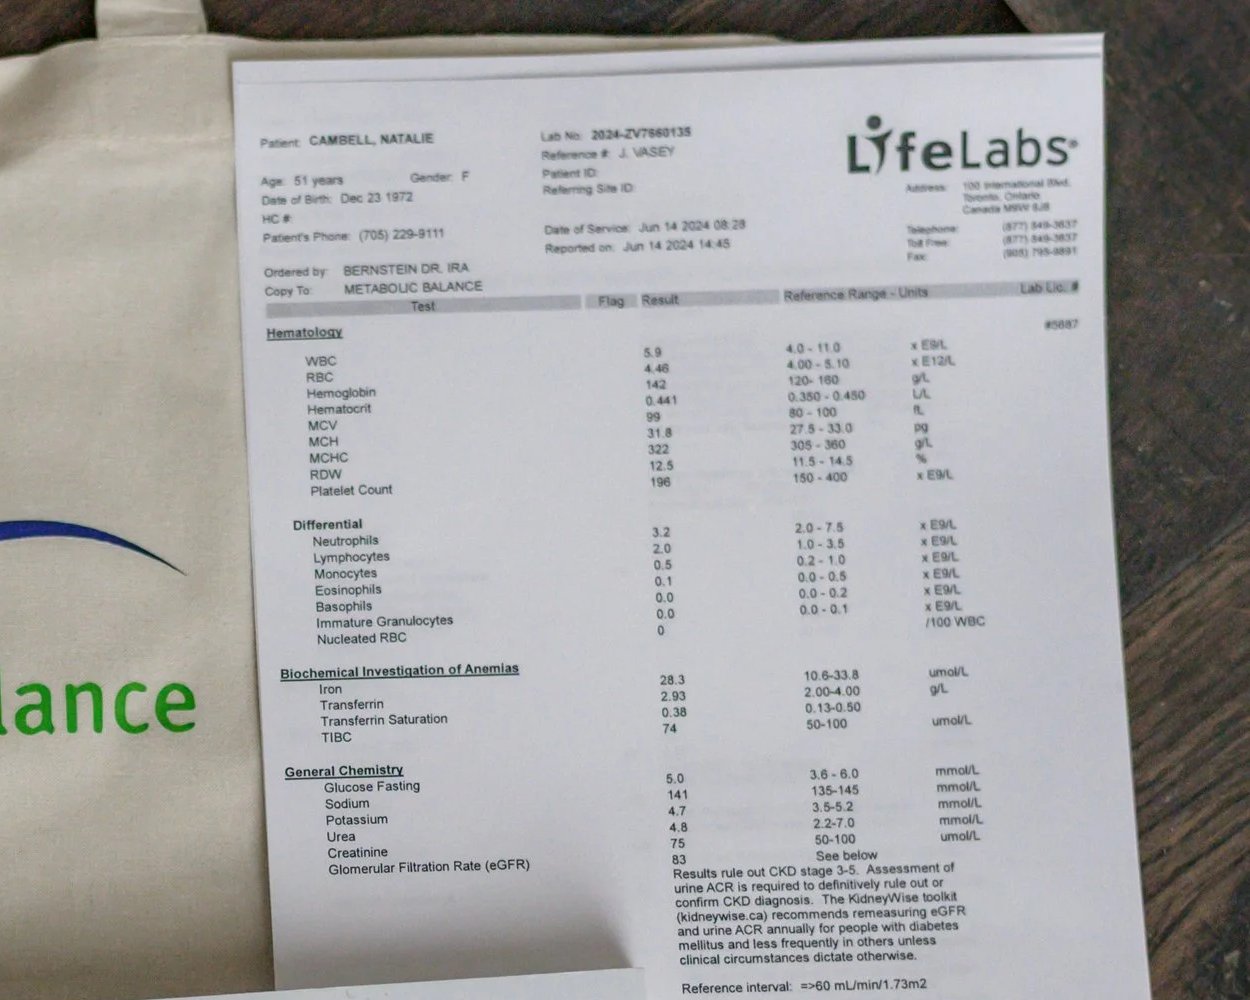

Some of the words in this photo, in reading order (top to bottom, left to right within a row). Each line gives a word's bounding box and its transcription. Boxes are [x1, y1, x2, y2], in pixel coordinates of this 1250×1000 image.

[266, 326, 343, 341] Hematology
[304, 354, 337, 367] WBC
[305, 370, 334, 383] RBC
[306, 386, 376, 401] Hemoglobin
[306, 402, 372, 415] Hematocrit
[307, 419, 338, 431] MCV
[308, 435, 339, 447] MCH
[308, 451, 349, 464] MCHC
[309, 468, 342, 480] RDW
[310, 484, 355, 497] Platelet
[357, 483, 393, 496] Count
[292, 517, 363, 531] Differential
[312, 534, 379, 548] Neutrophils
[312, 551, 390, 566] Lymphocytes
[313, 567, 378, 581] Monocytes
[314, 583, 382, 597] Eosinophils
[315, 599, 373, 614] Basophils
[316, 617, 373, 629] Immature
[375, 614, 454, 629] Granulocytes
[316, 632, 377, 645] Nucleated
[379, 631, 407, 643] RBC
[280, 667, 359, 681] Biochemical
[362, 665, 446, 680] Investigation
[448, 664, 462, 677] of
[464, 663, 519, 676] Anemias
[318, 683, 342, 695] Iron
[319, 698, 384, 711] Transferrin
[319, 714, 385, 727] Transferrin
[387, 713, 448, 725] Saturation
[320, 730, 352, 743] TIBC
[284, 765, 335, 778] General
[338, 764, 404, 778] Chemistry
[323, 781, 374, 793] Glucose
[376, 779, 420, 794] Fasting
[324, 797, 370, 810] Sodium
[325, 813, 388, 826] Potassium
[326, 830, 356, 843] Urea
[326, 846, 388, 859] Creatinine
[328, 862, 395, 875] Glomerular
[398, 860, 450, 873] Filtration
[452, 859, 481, 872] Rate
[484, 858, 530, 873] (eGFR)
[676, 909, 768, 925] (kidneywise.ca)
[771, 908, 849, 920] recommends
[852, 906, 927, 920] remeasuring
[930, 904, 966, 917] eGFR
[677, 924, 700, 937] and
[702, 924, 733, 936] urine
[734, 923, 763, 935] ACR
[767, 923, 815, 936] annually
[818, 922, 835, 934] for
[837, 921, 878, 936] people
[880, 921, 906, 932] with
[908, 920, 959, 932] diabetes
[678, 938, 725, 951] mellitus
[727, 938, 750, 950] and
[752, 937, 778, 949] less
[780, 936, 839, 951] frequently
[842, 936, 854, 947] in
[856, 935, 894, 947] others
[897, 934, 937, 946] unless
[678, 953, 720, 966] clinical
[722, 952, 810, 965] circumstances
[812, 951, 853, 963] dictate
[855, 949, 917, 962] otherwise.
[681, 982, 743, 994] Reference
[745, 980, 792, 993] interval:
